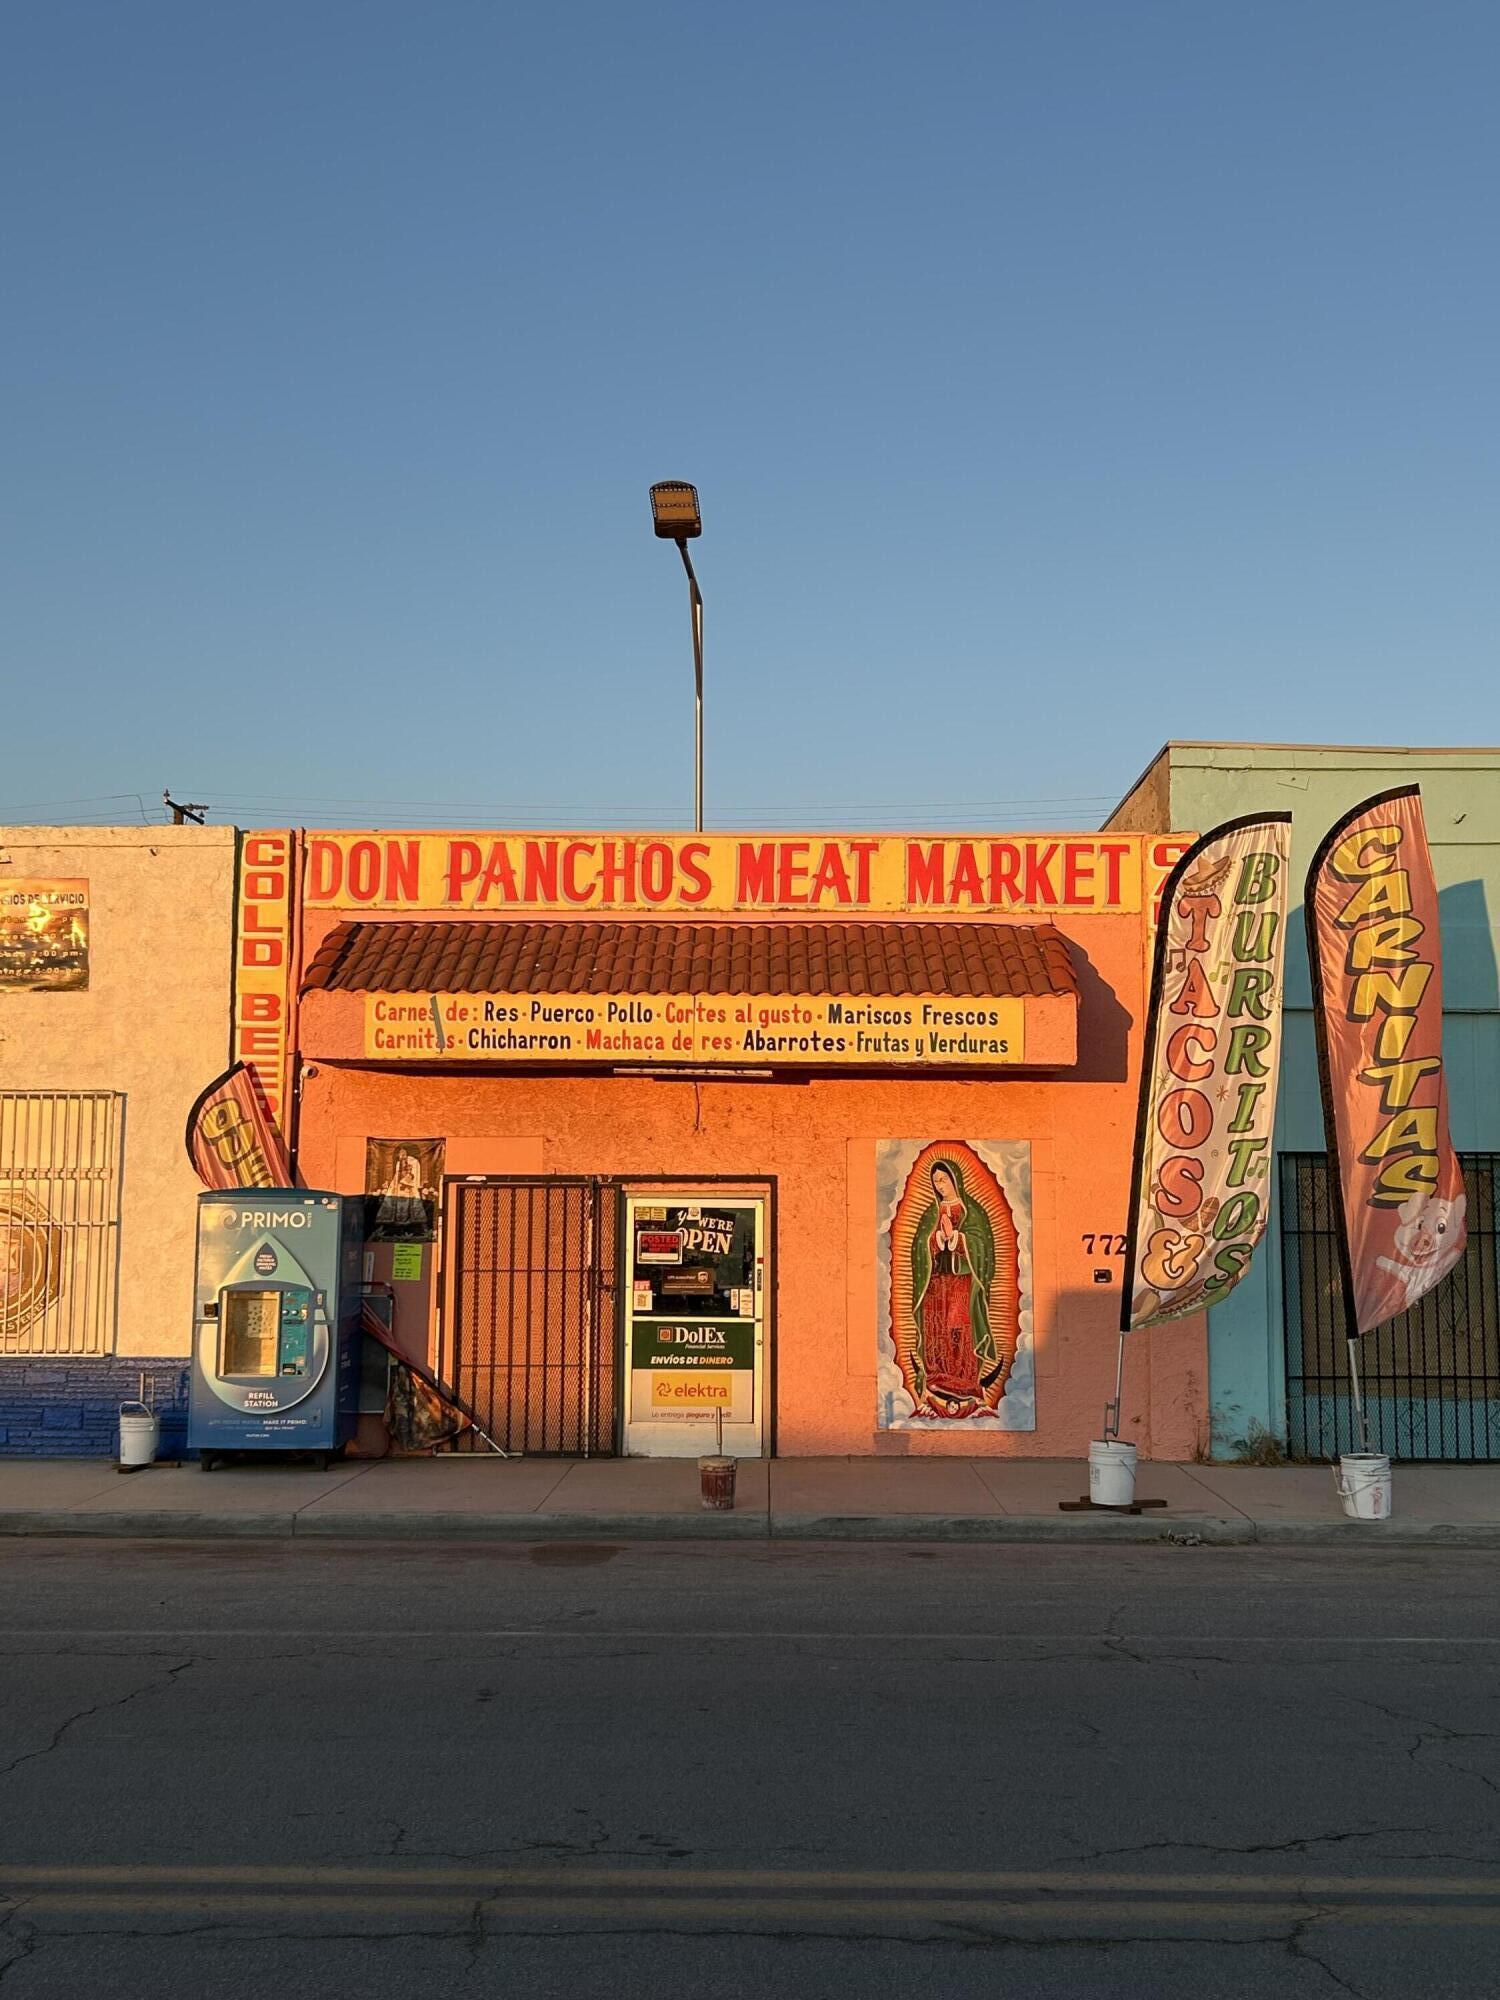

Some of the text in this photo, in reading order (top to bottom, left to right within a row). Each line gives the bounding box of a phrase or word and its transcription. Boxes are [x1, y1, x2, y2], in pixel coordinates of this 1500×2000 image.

[308, 840, 421, 903] DON
[442, 841, 713, 904] PANCHOS
[736, 842, 880, 905] MEAT
[904, 842, 1131, 906] MARKET
[243, 839, 286, 966] COLD
[375, 1001, 435, 1022] Carnes
[484, 1001, 519, 1022] Res
[530, 1001, 594, 1023] Puerco
[607, 1002, 652, 1023] Pollo
[665, 1003, 727, 1024] Cortes
[735, 1003, 753, 1023] al
[758, 1005, 813, 1028] gusto
[828, 1004, 913, 1026] Mariscos
[922, 1005, 999, 1027] Frescos
[1327, 825, 1441, 1210] CARNITAS
[375, 1027, 1009, 1057] Carnitas Chicharron Machaca de res Abarrotes Frutas y Verduras
[1154, 893, 1222, 1219] TACOS
[1202, 852, 1281, 1290] BURRITOS
[241, 1211, 306, 1229] PRIMO
[1141, 1228, 1206, 1291] &
[674, 1327, 726, 1343] DolEx
[650, 1354, 734, 1365] ENVÍOS DE DINERO
[243, 1400, 279, 1408] STATION
[248, 1392, 275, 1400] REFILL
[674, 1383, 728, 1398] elektra
